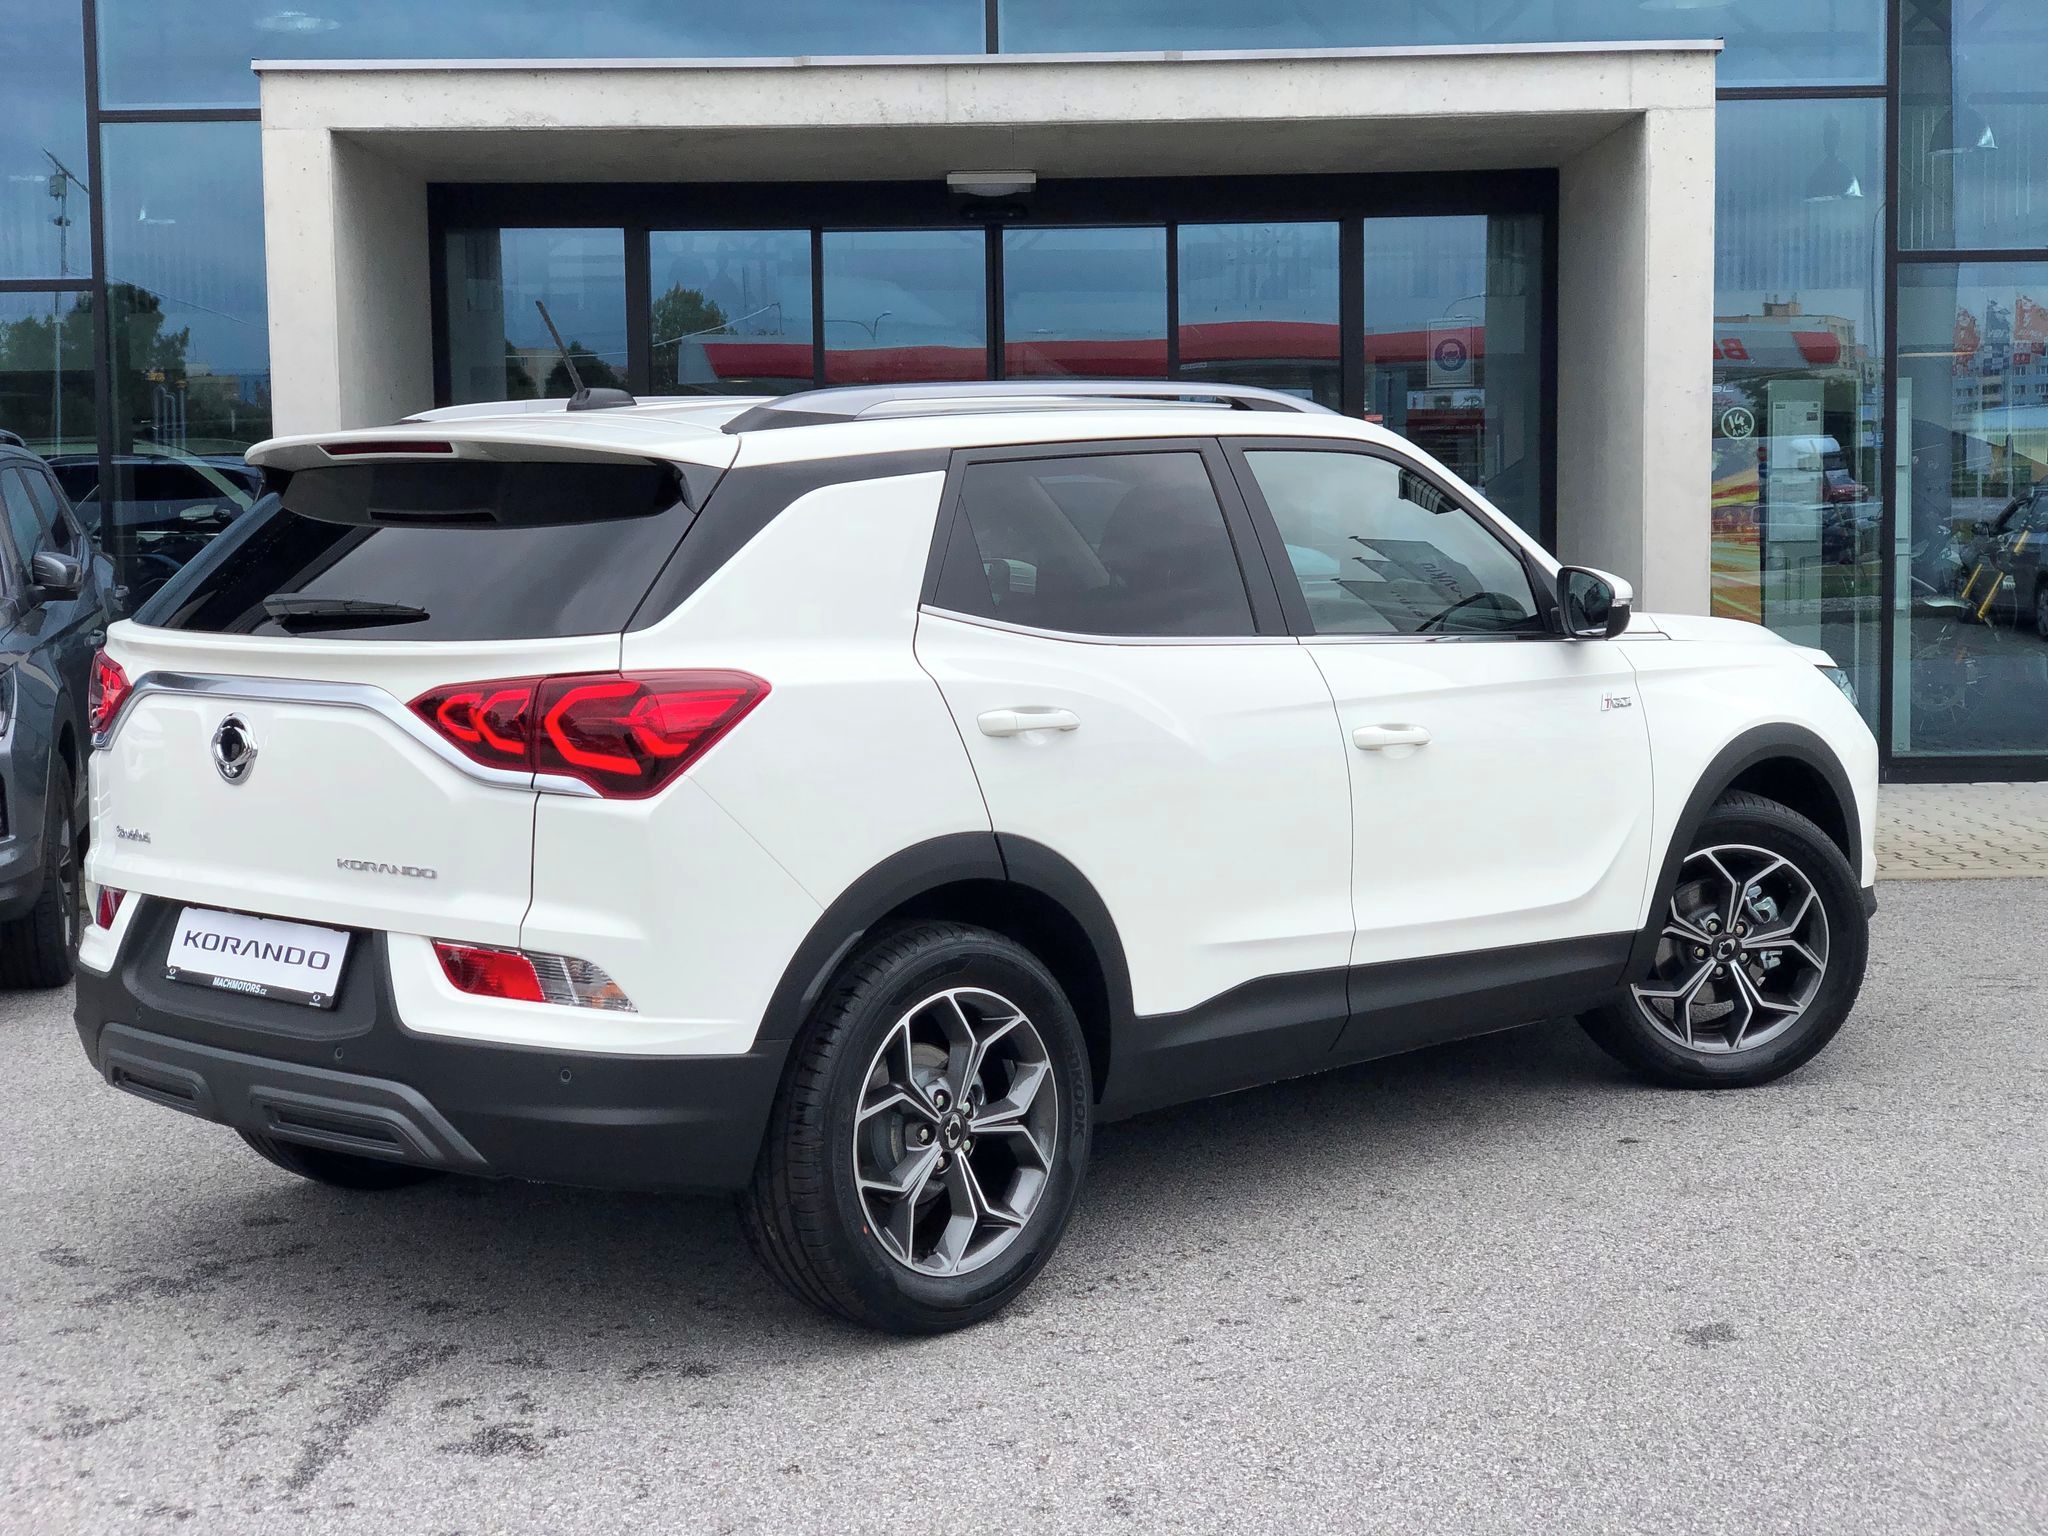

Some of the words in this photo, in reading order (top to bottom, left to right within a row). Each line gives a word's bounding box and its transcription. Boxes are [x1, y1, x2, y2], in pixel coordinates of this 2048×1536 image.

[336, 858, 438, 879] KORANDO
[183, 930, 331, 970] KORANDO
[212, 976, 268, 995] MACHMOTORS.cz
